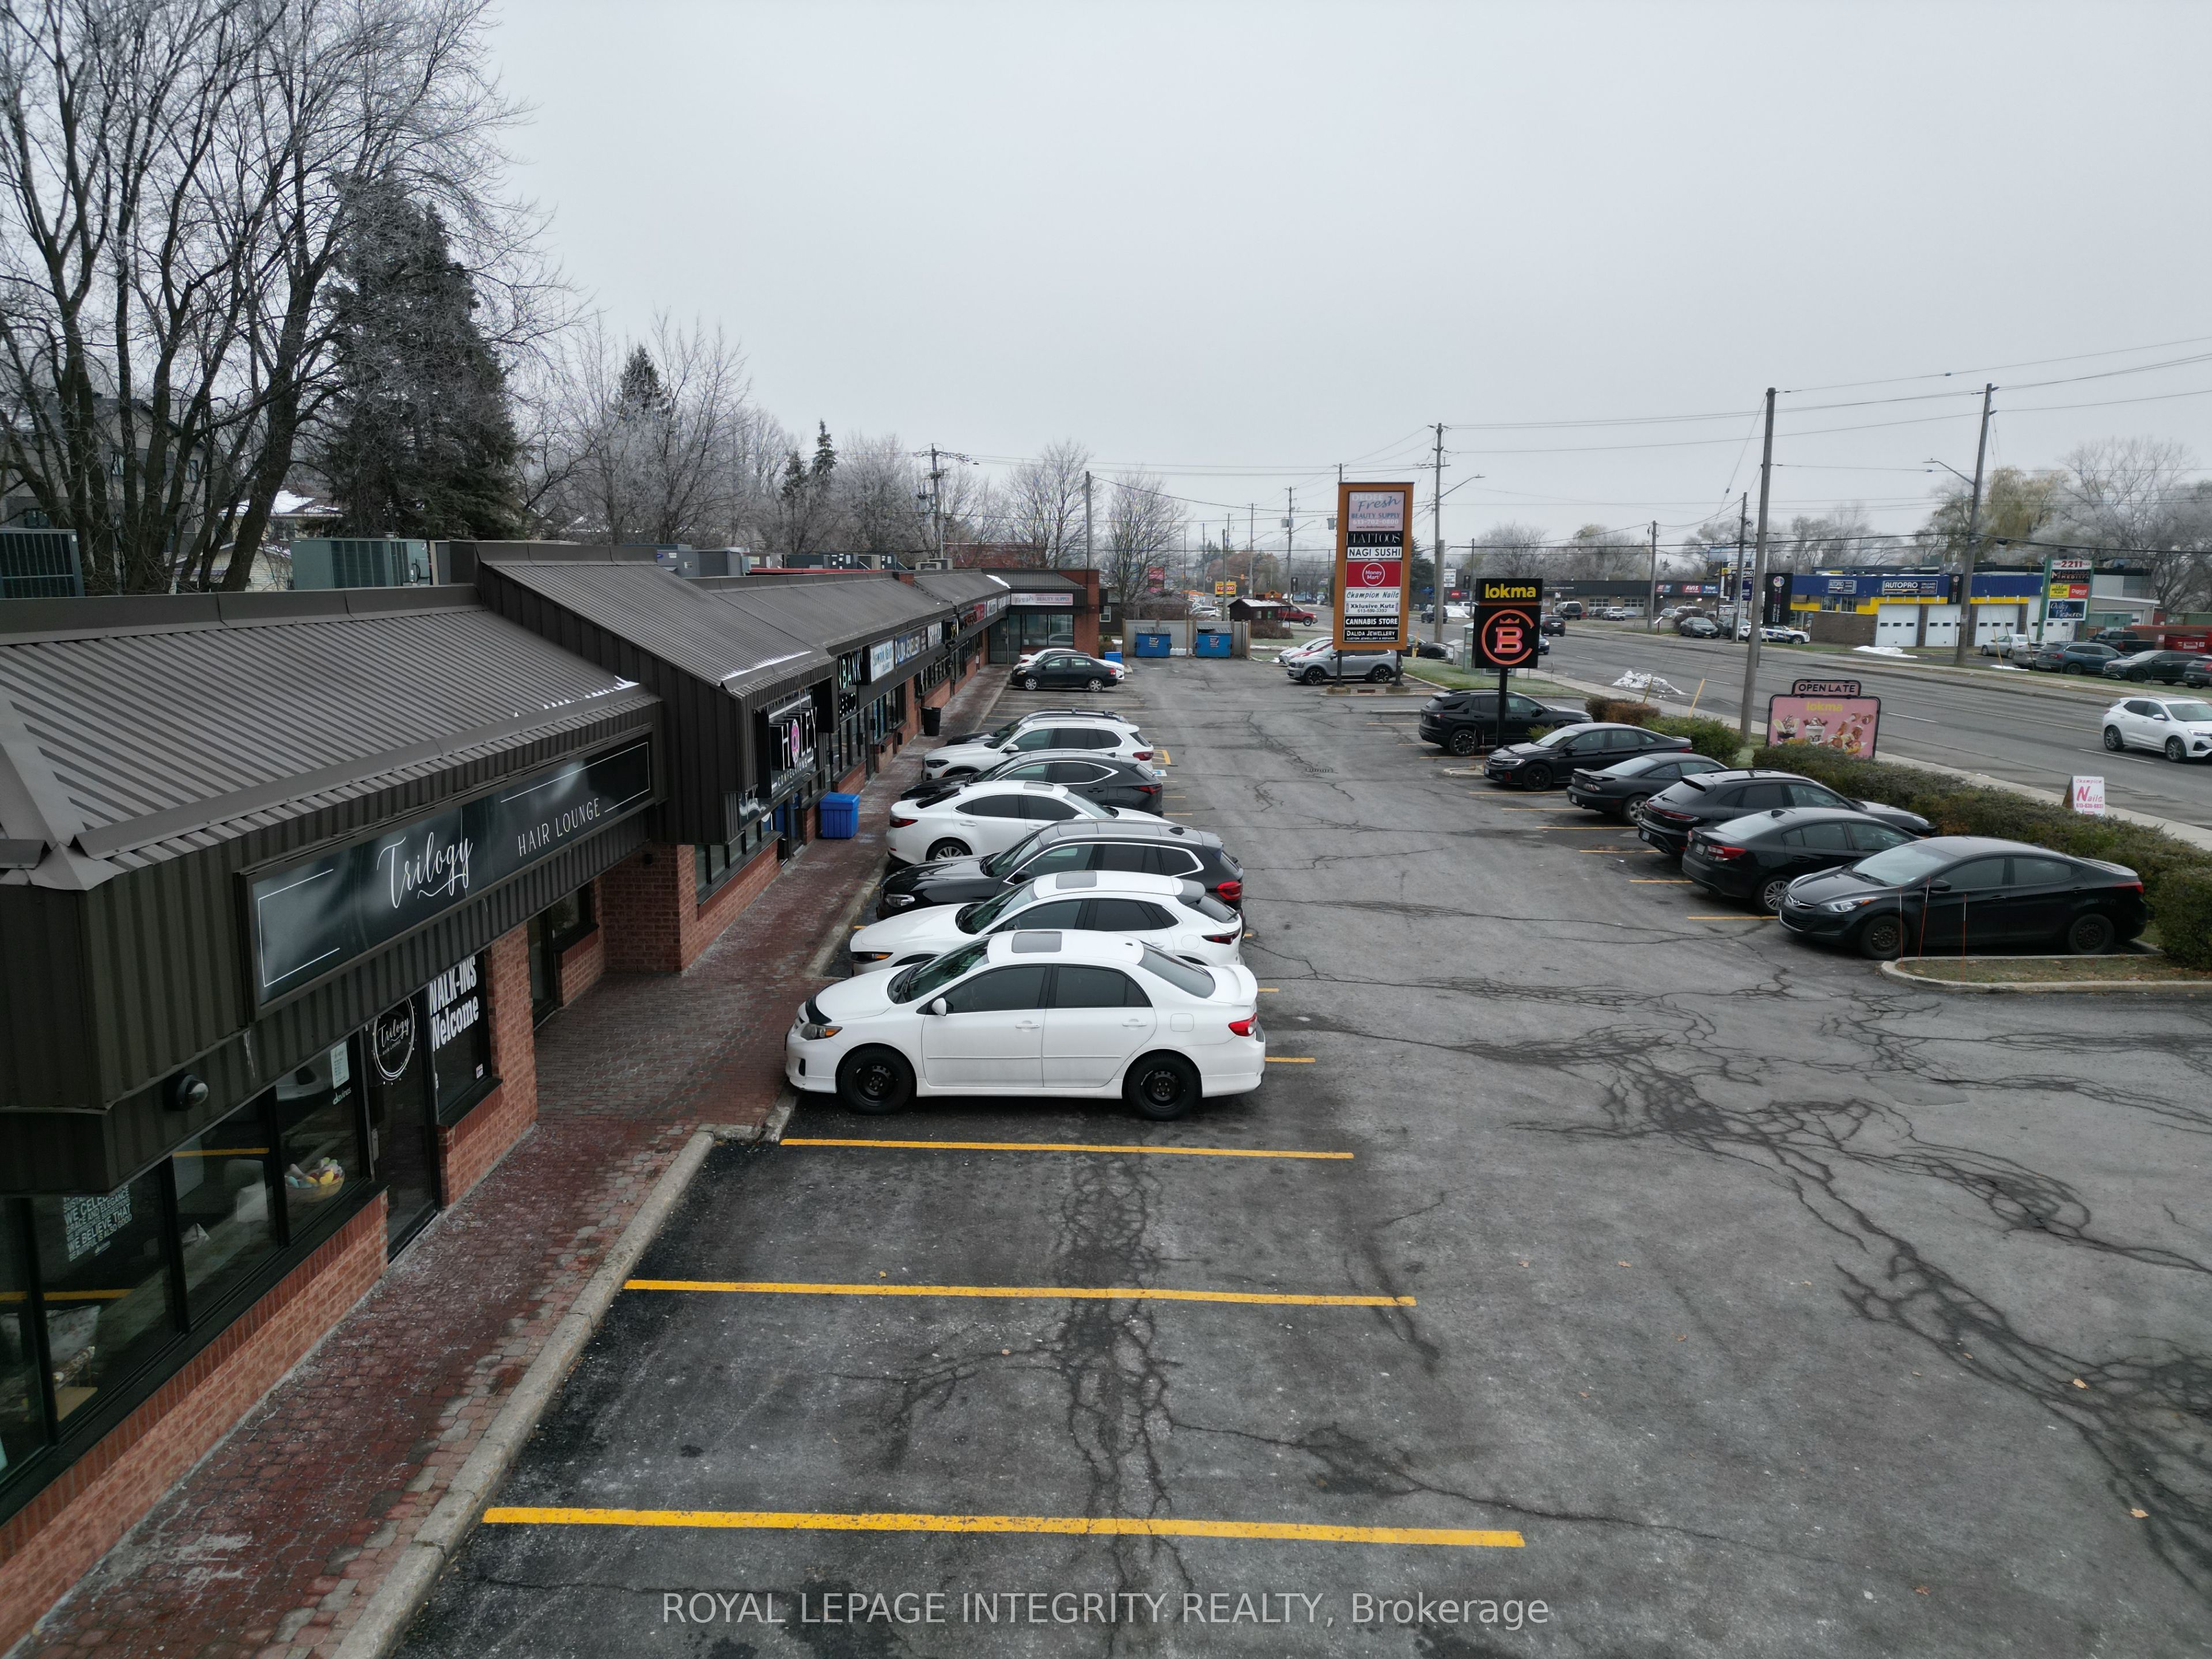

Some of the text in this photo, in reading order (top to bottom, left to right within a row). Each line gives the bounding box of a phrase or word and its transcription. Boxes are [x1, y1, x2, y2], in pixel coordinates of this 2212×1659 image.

[1358, 496, 1401, 512] Fresh
[1351, 533, 1400, 543] TATTOOS
[1349, 548, 1400, 556] NAGI SUSHI
[1485, 583, 1536, 599] lokma
[1798, 684, 1856, 692] OPEN LATE
[1806, 702, 1843, 712] lokma
[778, 759, 808, 786] CONFECTIONS
[2077, 786, 2103, 802] Nails
[518, 798, 600, 857] HAIR LOUNGE
[377, 832, 474, 909] Trilogy
[377, 1017, 410, 1047] Trilogy
[66, 1215, 87, 1235] GRACE
[88, 1208, 100, 1222] AND
[100, 1188, 130, 1213] ELEGANCE
[82, 1215, 112, 1244] BELIEVE
[113, 1203, 131, 1222] THAT
[118, 1213, 132, 1228] GOOD
